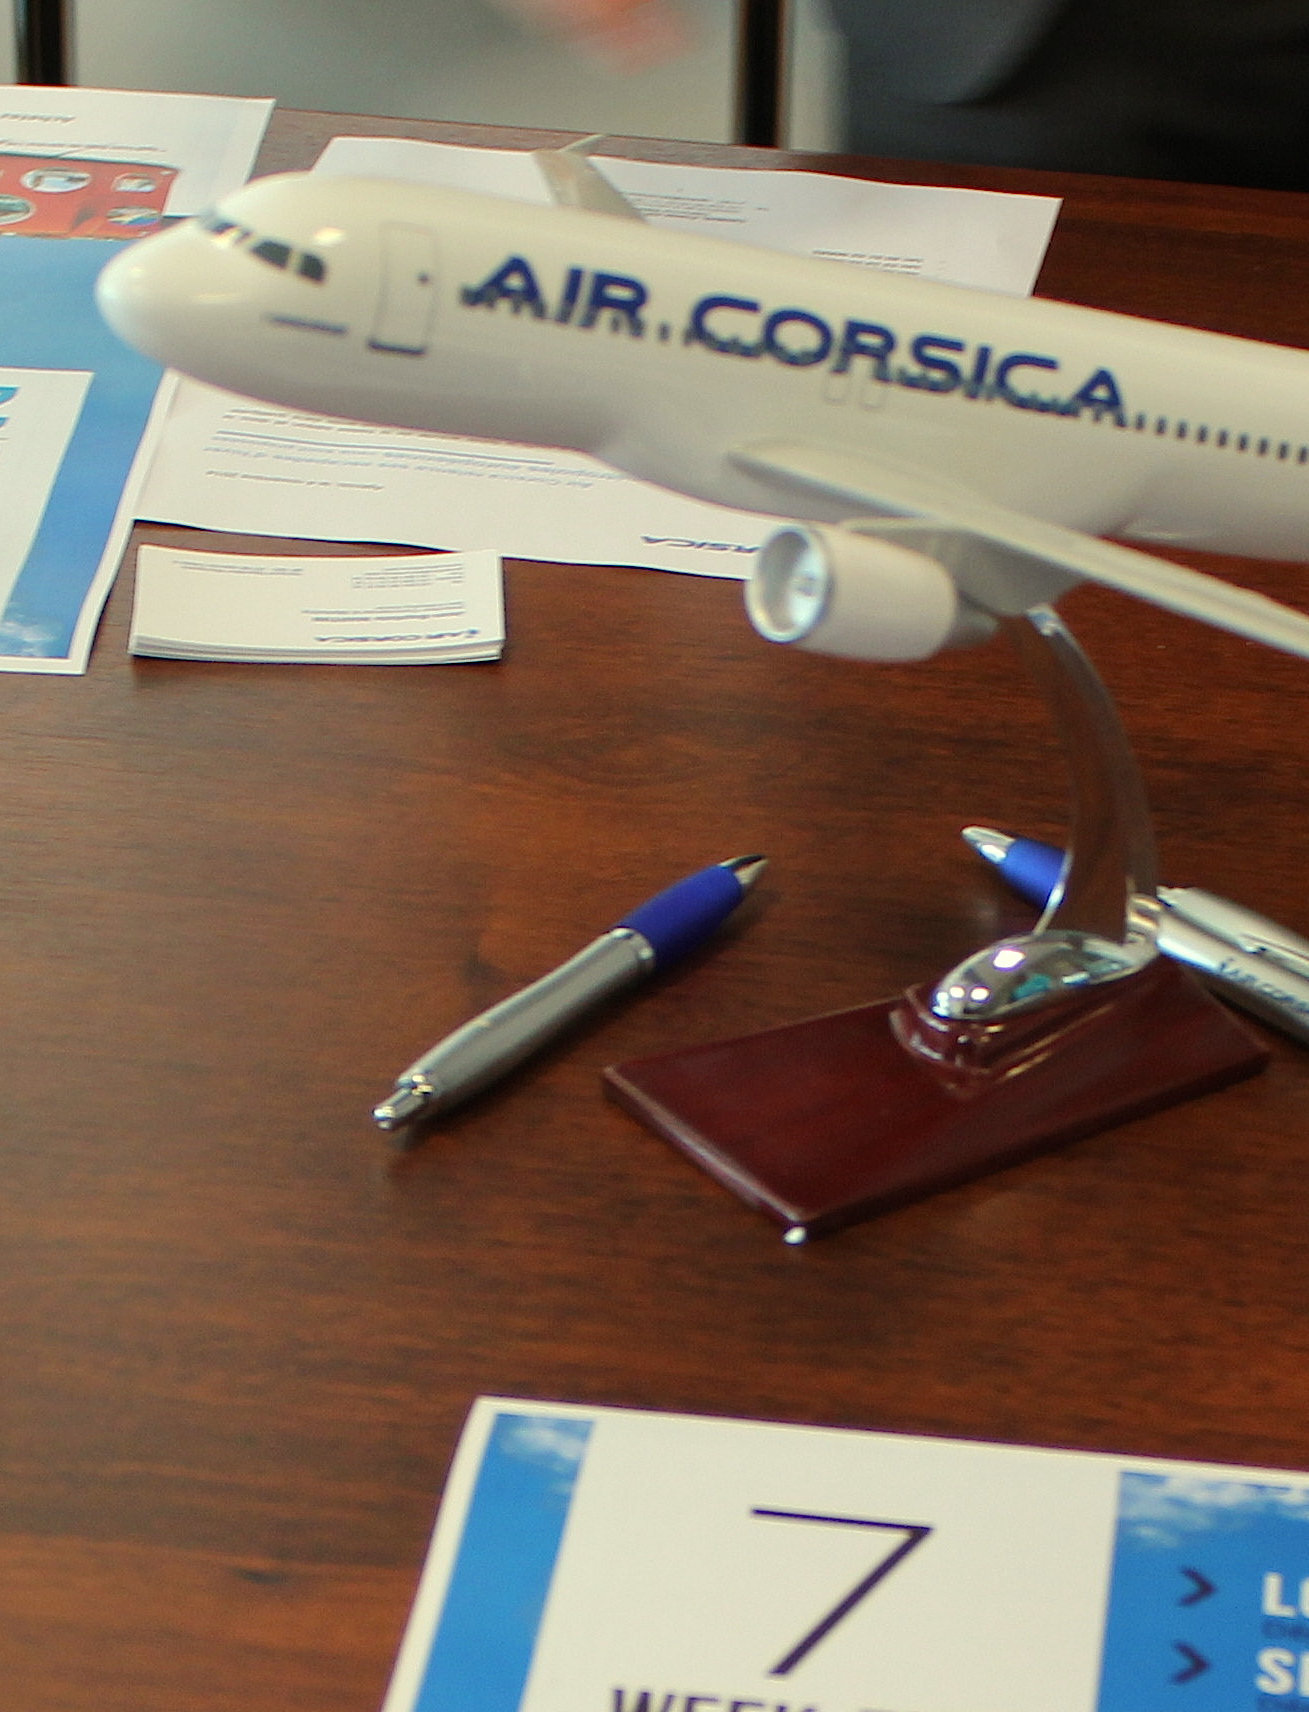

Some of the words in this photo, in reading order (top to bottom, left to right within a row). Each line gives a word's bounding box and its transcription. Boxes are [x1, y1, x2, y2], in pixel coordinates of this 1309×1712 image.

[460, 256, 649, 336] AIR
[690, 294, 1125, 424] CORSICA
[750, 1506, 935, 1679] 7
